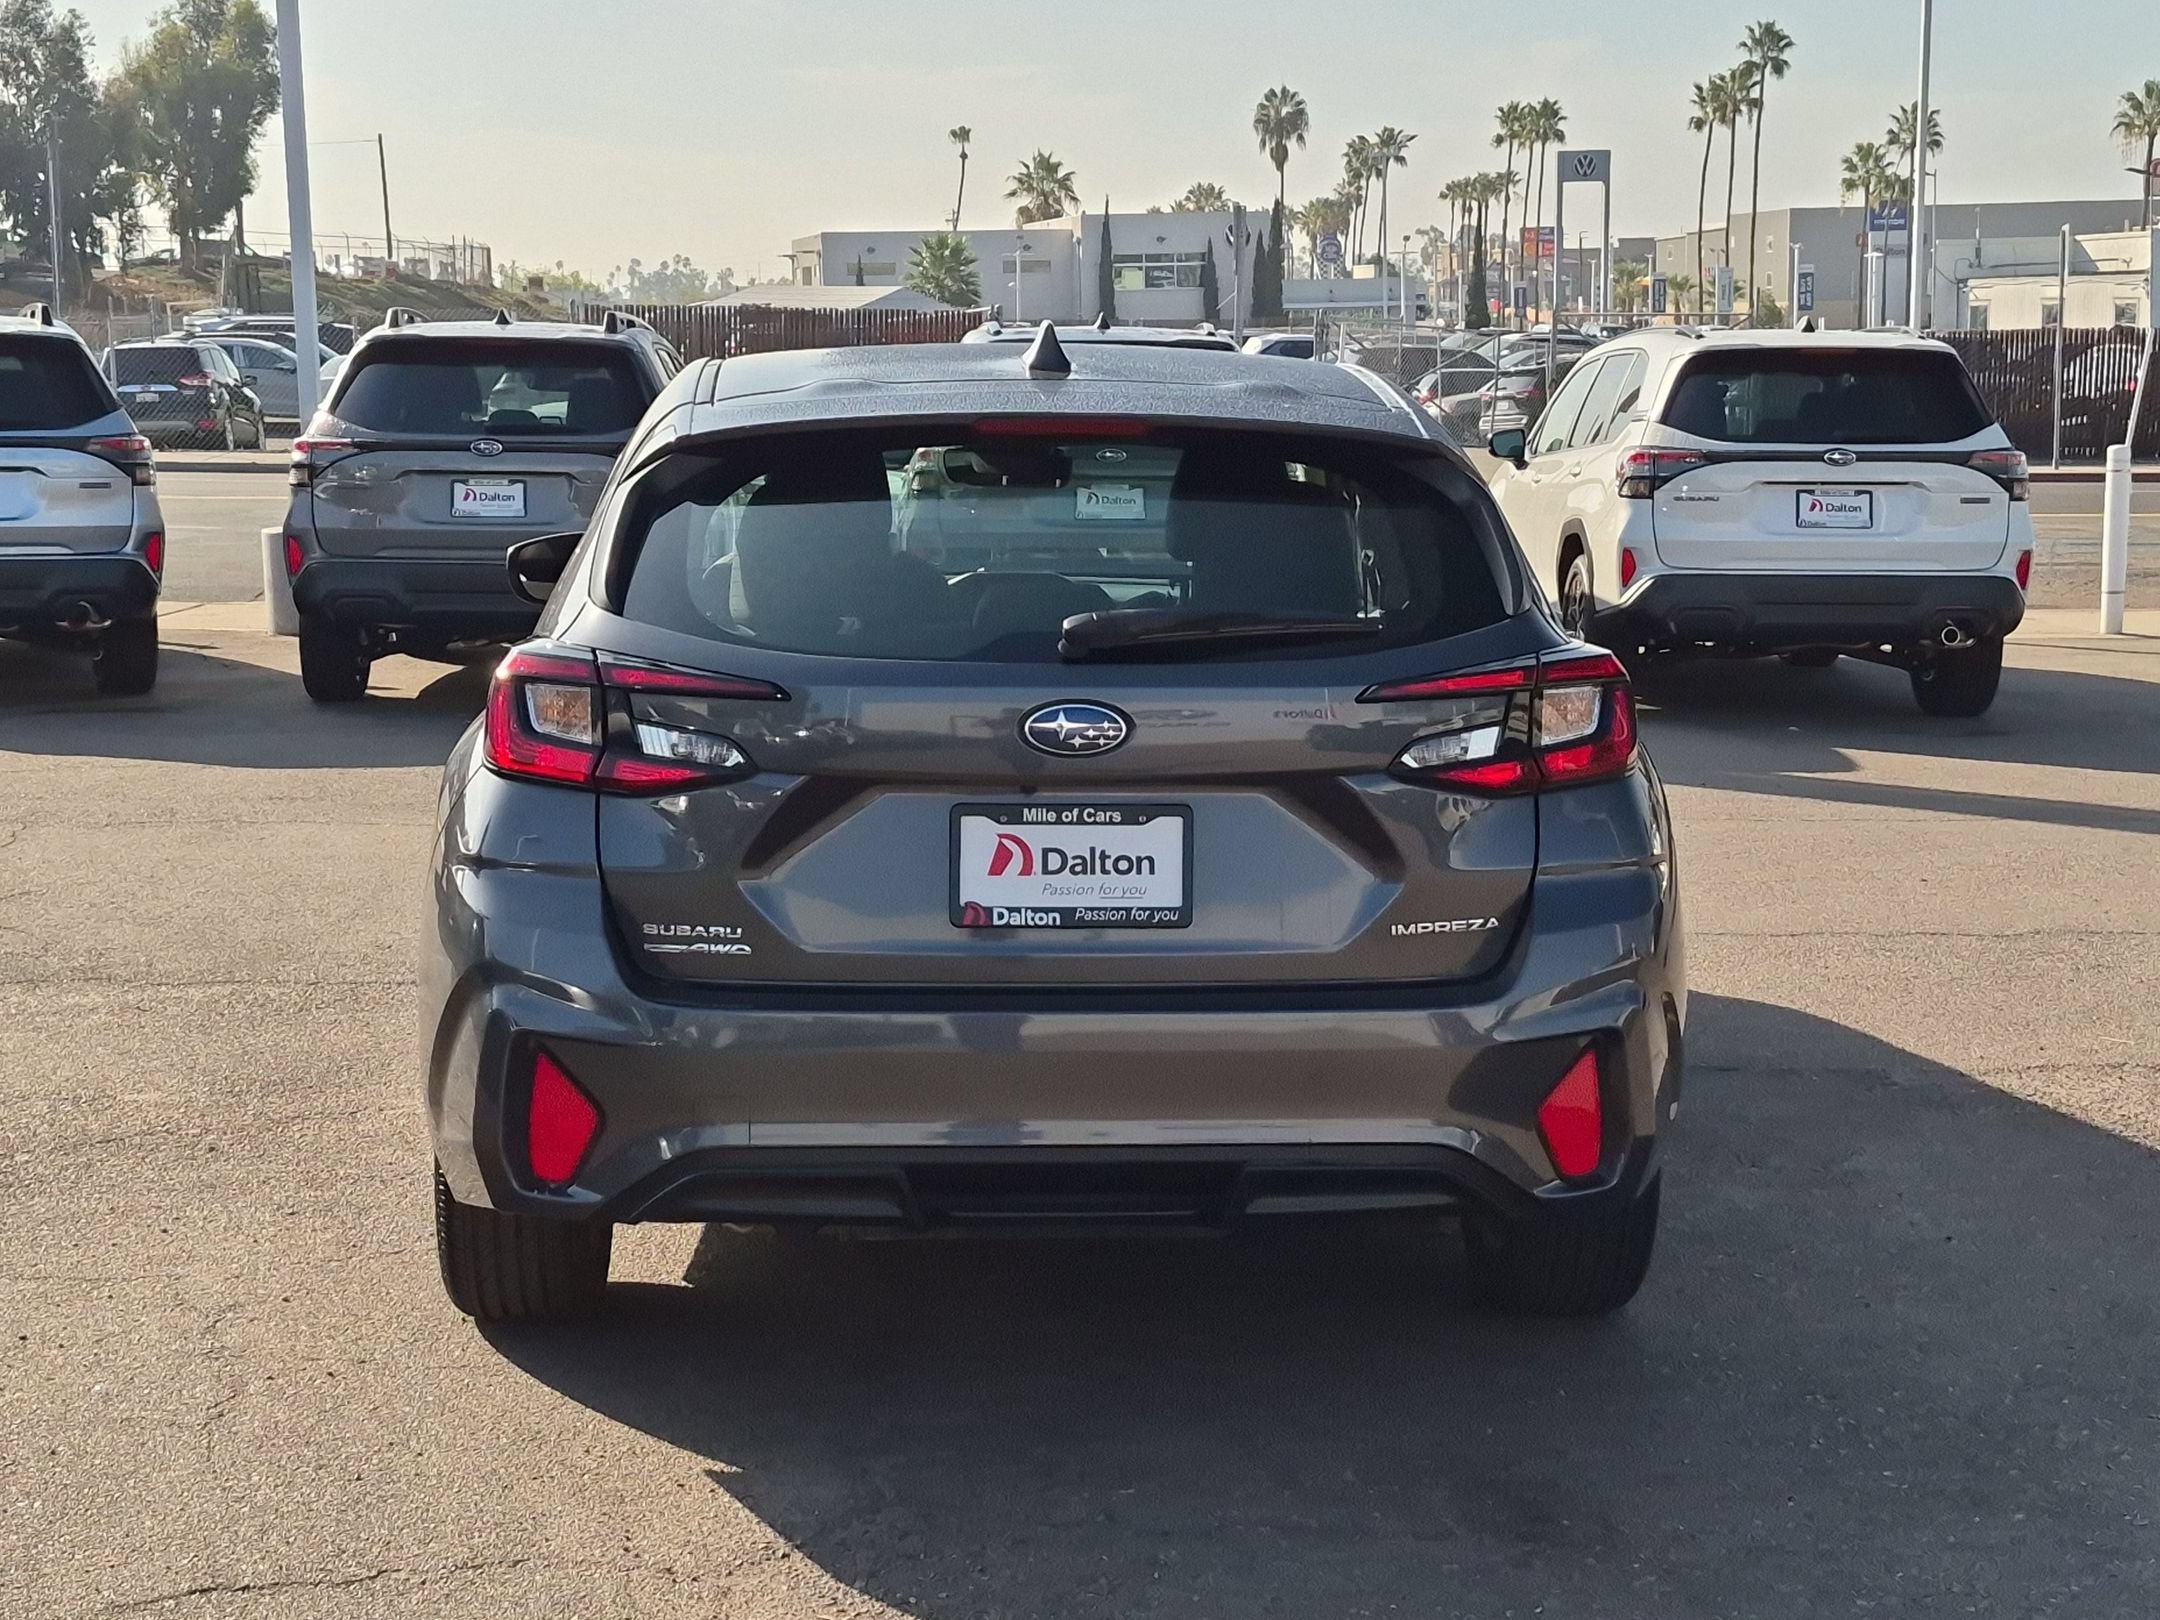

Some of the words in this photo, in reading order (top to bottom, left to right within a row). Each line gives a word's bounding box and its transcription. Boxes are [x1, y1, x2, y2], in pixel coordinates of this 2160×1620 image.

[479, 492, 516, 502] Dalton
[1101, 495, 1137, 505] Dalton
[1825, 503, 1862, 513] Dalton
[1023, 807, 1057, 823] Mile
[1062, 807, 1079, 823] of
[1083, 807, 1122, 823] Cars
[1041, 846, 1156, 876] Dalton
[1041, 883, 1094, 896] Passion
[1100, 882, 1119, 897] for
[1121, 886, 1147, 899] you
[993, 906, 1061, 926] Dalton
[1075, 907, 1126, 921] Passion
[1130, 907, 1151, 921] for
[1153, 910, 1179, 924] you
[642, 923, 743, 939] SUBARU
[1391, 917, 1499, 937] IMPREZA
[684, 942, 752, 955] AWD
